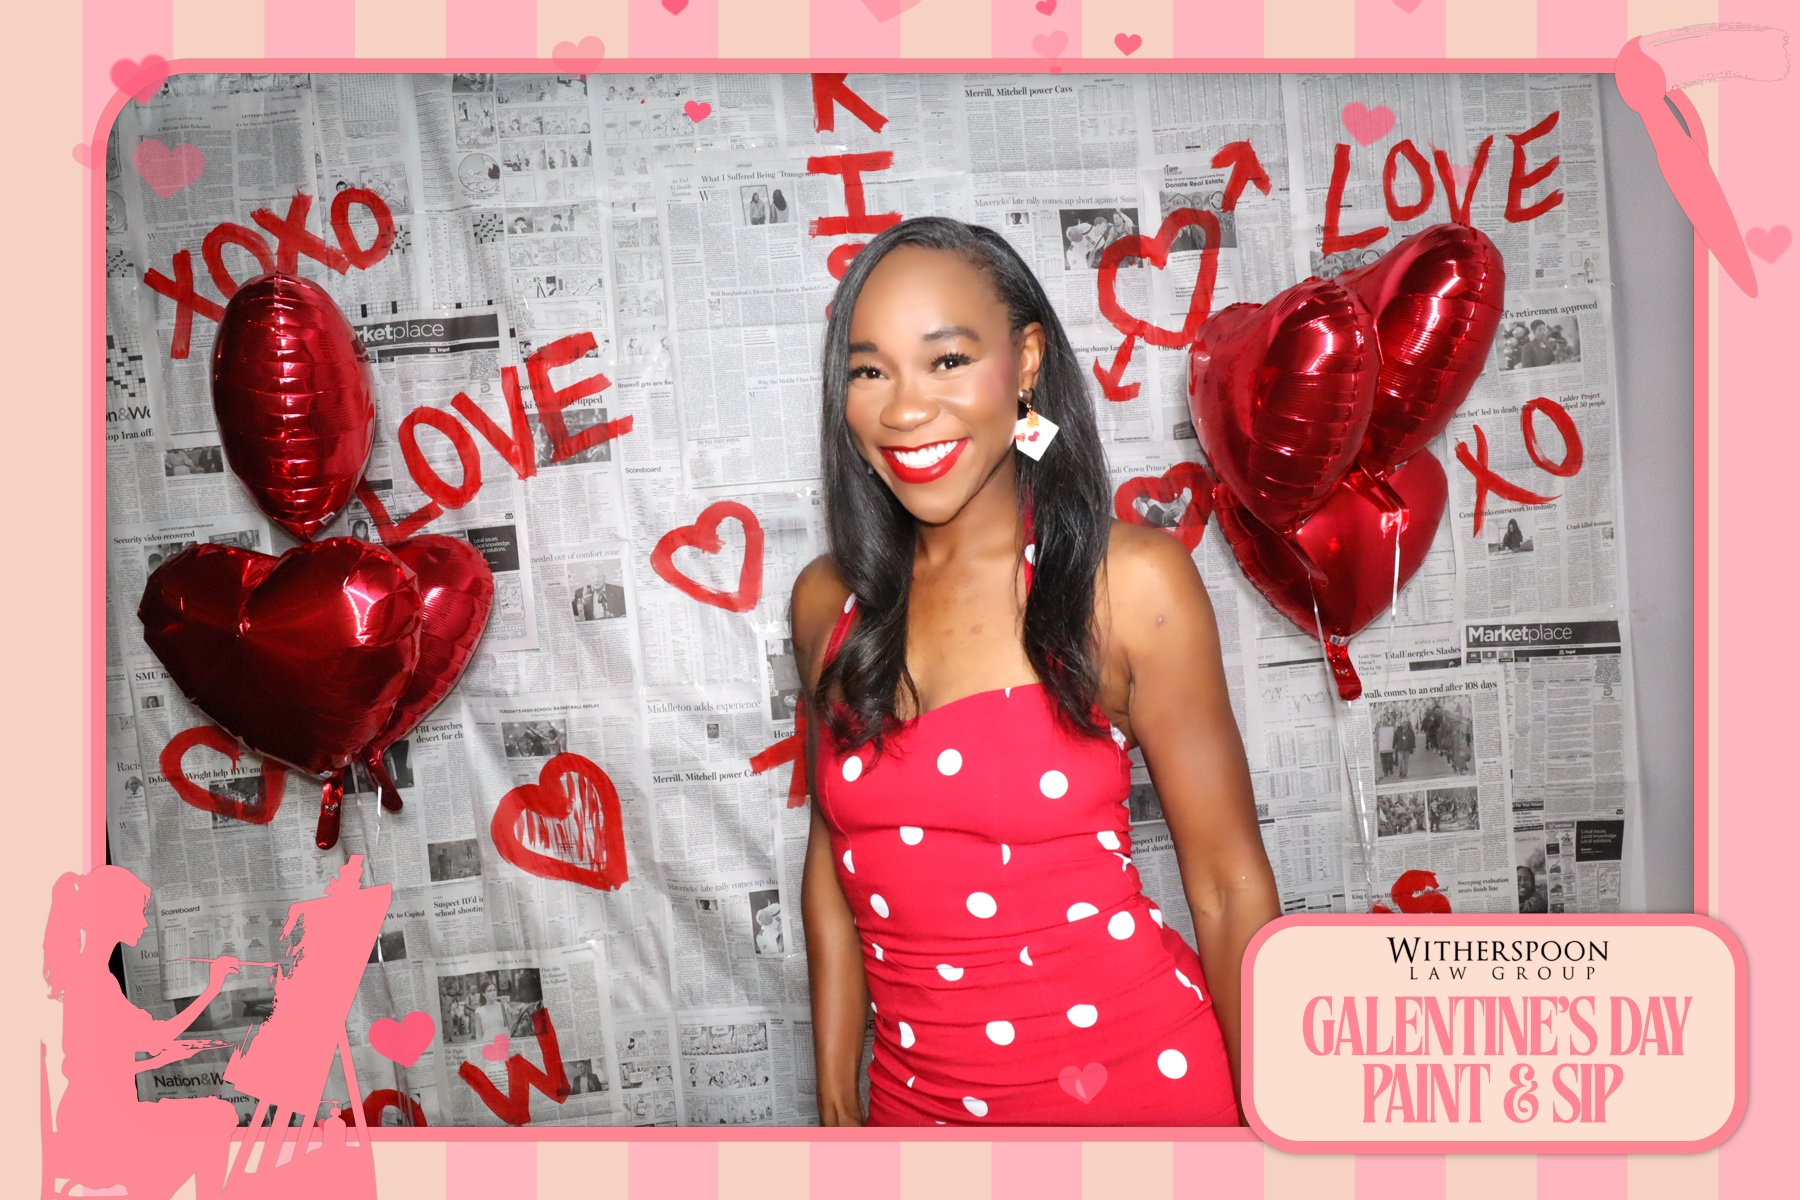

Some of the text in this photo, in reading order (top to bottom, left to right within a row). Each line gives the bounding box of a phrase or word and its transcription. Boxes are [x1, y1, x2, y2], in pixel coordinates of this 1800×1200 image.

[965, 85, 1073, 98] Merrill, Mitchell power Cavs
[701, 174, 720, 183] What
[727, 171, 755, 181] Suffered
[756, 171, 776, 180] Being
[1321, 110, 1563, 258] LOVE
[974, 197, 1011, 207] Mavericks'
[1012, 197, 1024, 205] late
[1026, 196, 1040, 206] rally
[1065, 198, 1074, 206] up
[1075, 196, 1093, 204] short
[1094, 196, 1118, 205] against
[144, 187, 395, 359] XOXO
[1516, 305, 1559, 318] retirement
[1560, 301, 1598, 315] approved
[358, 321, 444, 343] rketplace
[640, 381, 652, 389] gets
[1559, 392, 1600, 403] Ladder Project
[1481, 408, 1492, 416] led
[1500, 405, 1519, 414] deadly
[1579, 401, 1588, 409] 50
[1588, 400, 1607, 408] people
[121, 430, 139, 440] Iran
[354, 331, 634, 543] LOVE
[625, 465, 661, 474] Scoreboard
[1454, 397, 1584, 539] XO
[1495, 505, 1526, 515] coursework
[1533, 502, 1557, 511] industry
[113, 530, 195, 544] Security video recovered
[485, 540, 511, 548] knowledge.
[532, 549, 620, 564] needed out of comfort zone
[1468, 624, 1573, 644] Marketplace
[1384, 646, 1461, 660] TotalEnergies Slashes
[135, 671, 159, 682] SMU
[1364, 689, 1382, 699] walk
[1384, 688, 1407, 697] comes
[1409, 687, 1416, 696] to
[1430, 684, 1444, 693] end
[1445, 682, 1463, 692] after
[1464, 681, 1479, 691] 108
[1480, 679, 1497, 691] days
[647, 699, 761, 715] Middleton adds experience
[415, 722, 463, 734] FBI searches
[416, 731, 450, 744] desert for
[116, 761, 142, 772] Racis
[185, 771, 211, 781] Wright
[213, 768, 229, 779] help
[231, 766, 248, 776] BYU
[653, 769, 763, 784] Merrill, Mitchell power Cavs
[1130, 834, 1169, 846] Suspect ID'd
[1130, 843, 1176, 855] school shootin
[700, 884, 713, 892] late
[715, 882, 730, 892] rally
[732, 881, 753, 890] comes
[755, 880, 764, 888] up
[765, 877, 779, 885] sho
[1457, 877, 1509, 888] Sweeping evaluation
[433, 895, 477, 910] Suspect ID'd
[160, 905, 200, 916] Scoreboard
[404, 910, 425, 918] Capitol
[434, 905, 483, 918] school shootin
[140, 949, 159, 960] Roa
[153, 1072, 233, 1088] Nation&W
